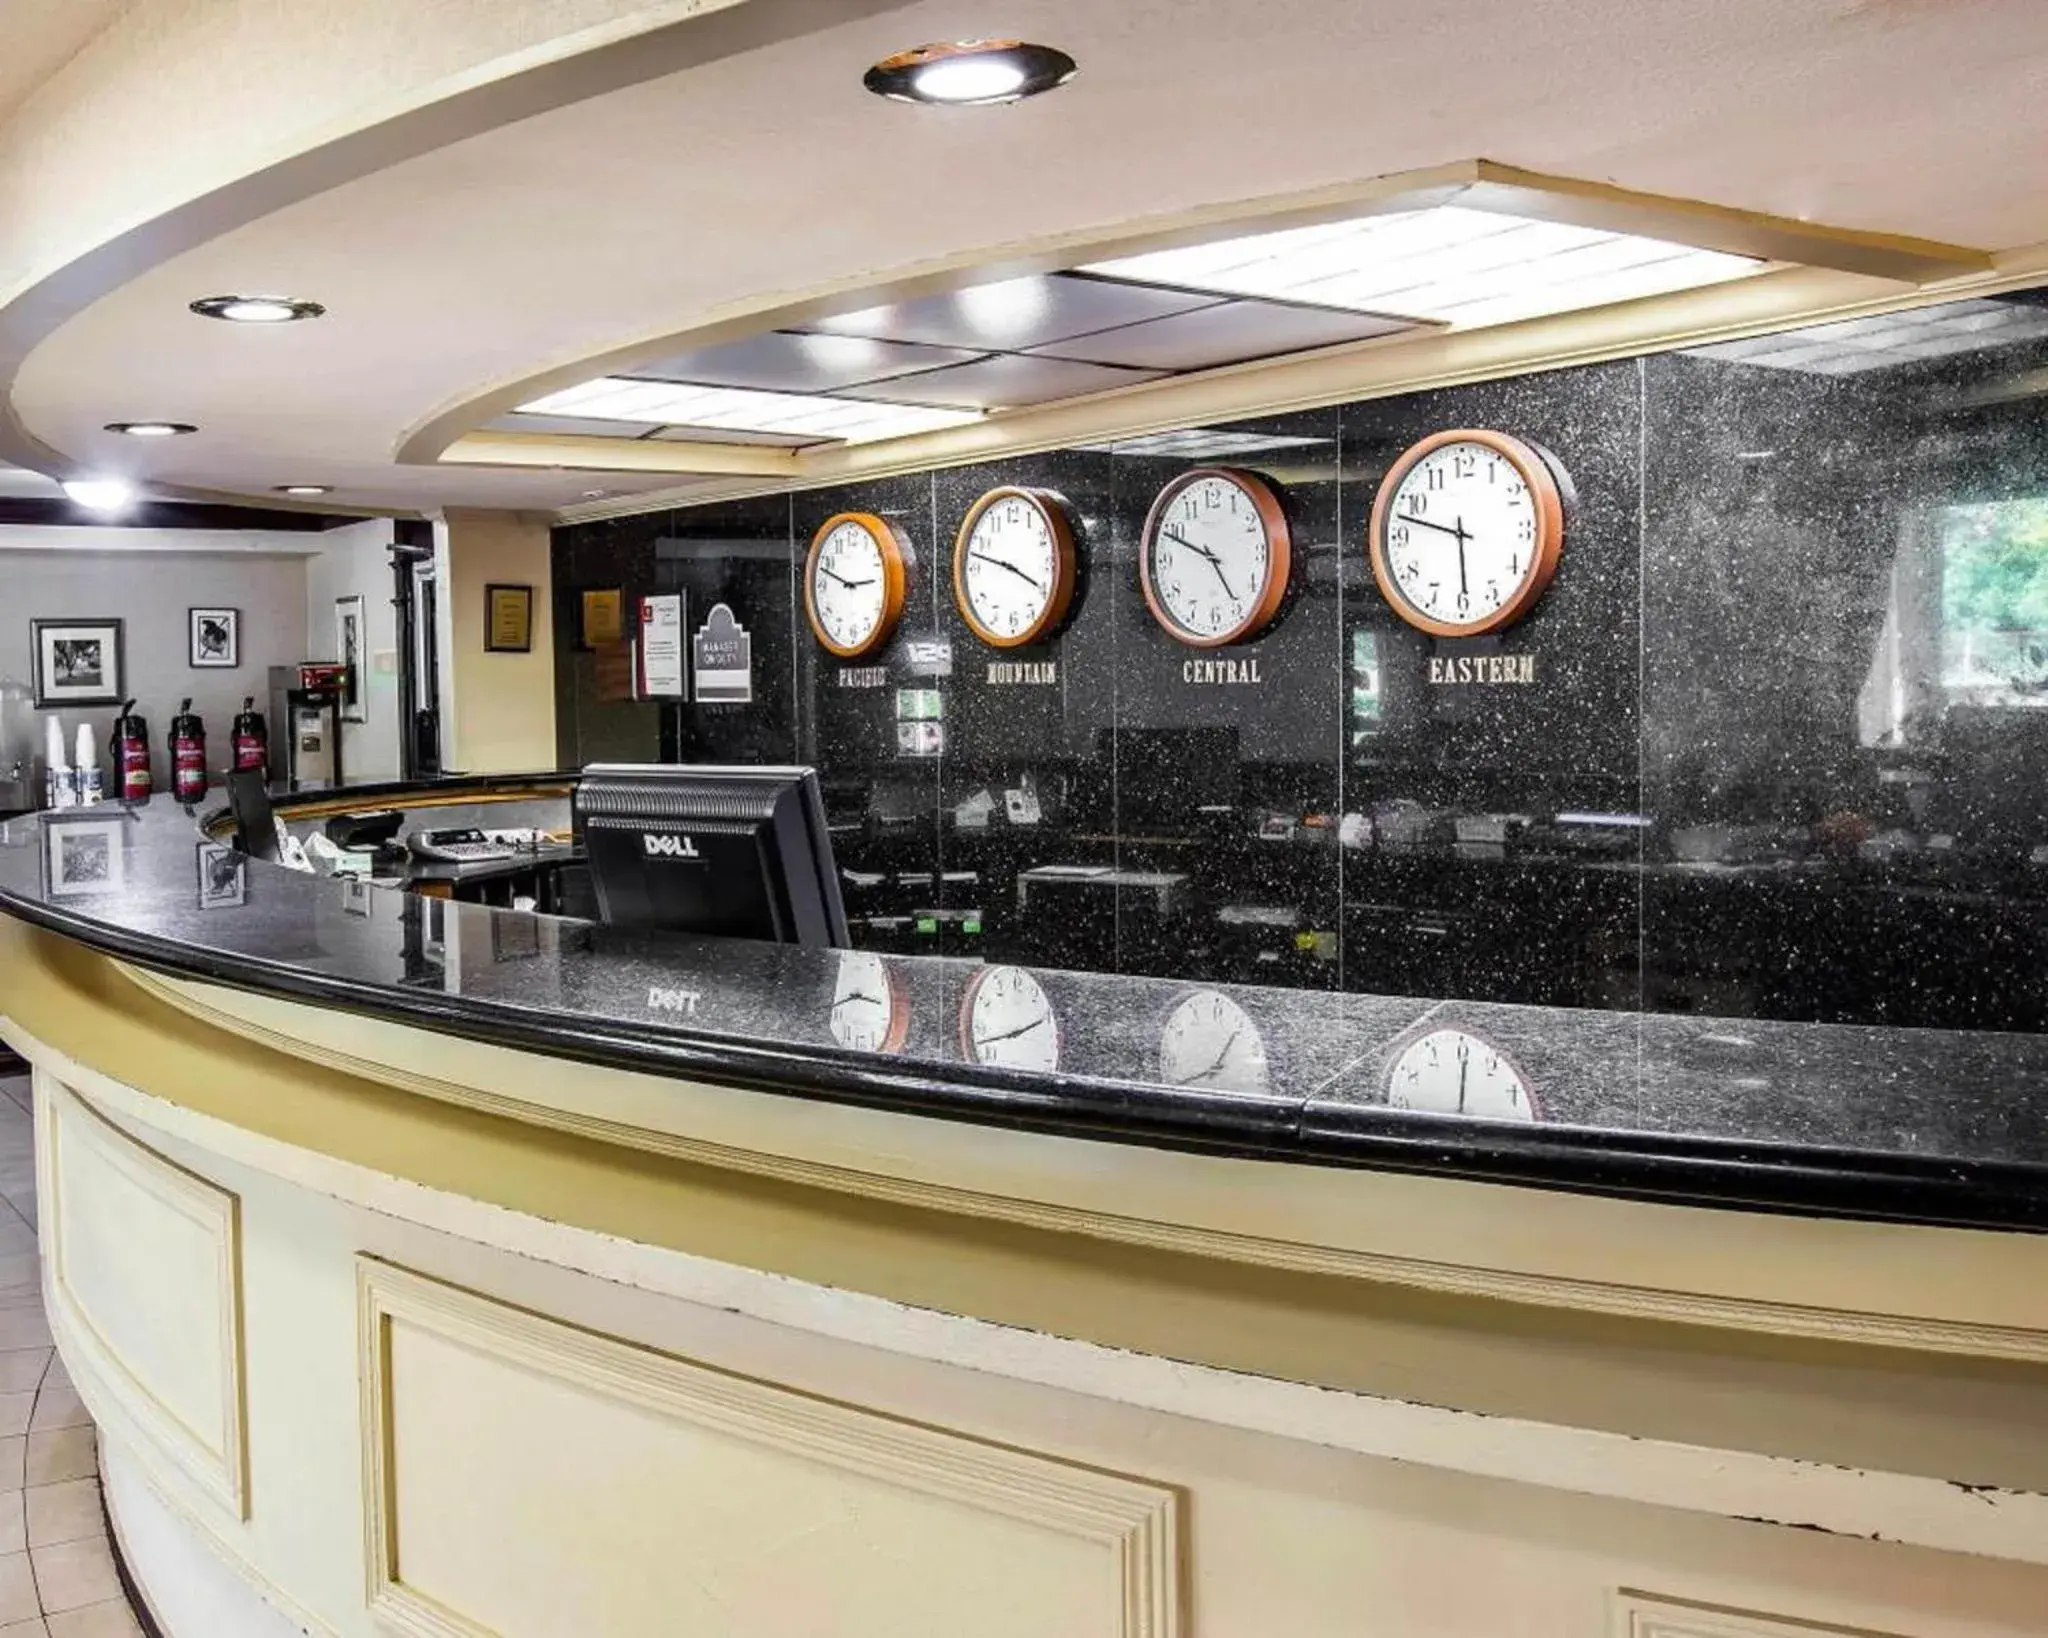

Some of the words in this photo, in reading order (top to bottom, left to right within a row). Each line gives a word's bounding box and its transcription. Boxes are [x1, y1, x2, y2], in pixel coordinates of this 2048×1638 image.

[1428, 468, 1443, 490] 11
[1453, 456, 1475, 479] 12
[1488, 462, 1495, 484] 1
[1407, 492, 1427, 516] 10
[1506, 483, 1521, 507] 2
[1397, 526, 1409, 548] 9
[1518, 519, 1531, 541] 3
[1406, 560, 1419, 582] 8
[1505, 552, 1519, 575] 4
[1428, 582, 1440, 605] 7
[1457, 590, 1469, 612] 6
[1485, 579, 1499, 601] 5
[1183, 659, 1261, 684] CENTRAL
[1429, 655, 1536, 684] EASTERN
[644, 834, 699, 857] DELL
